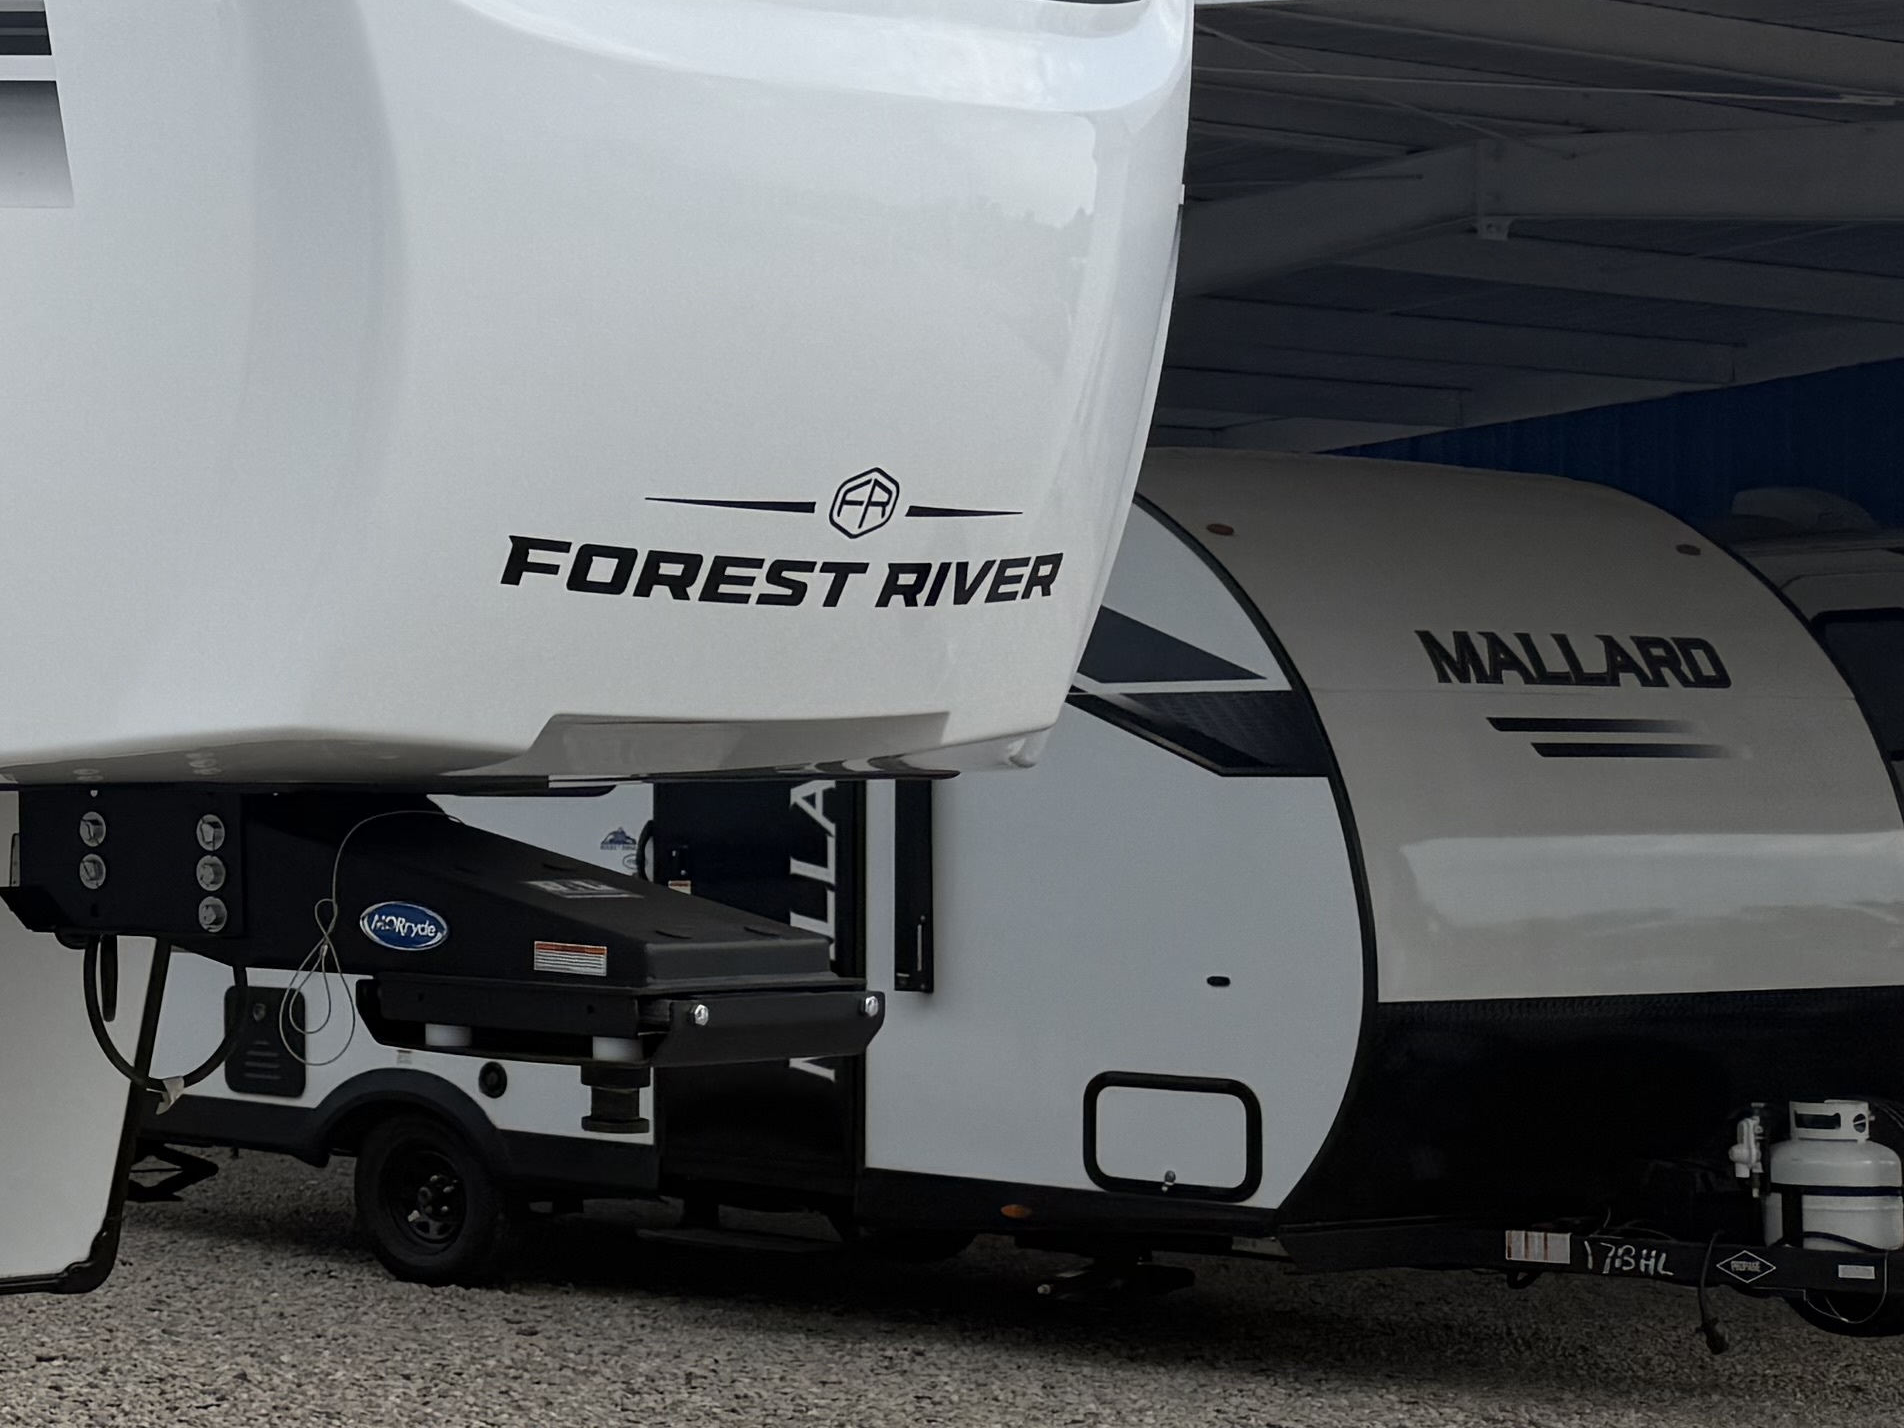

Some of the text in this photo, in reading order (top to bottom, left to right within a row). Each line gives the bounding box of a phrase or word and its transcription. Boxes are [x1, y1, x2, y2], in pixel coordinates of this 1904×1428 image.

[500, 535, 1064, 608] FOREST RIVER
[1414, 629, 1732, 689] MALLARD
